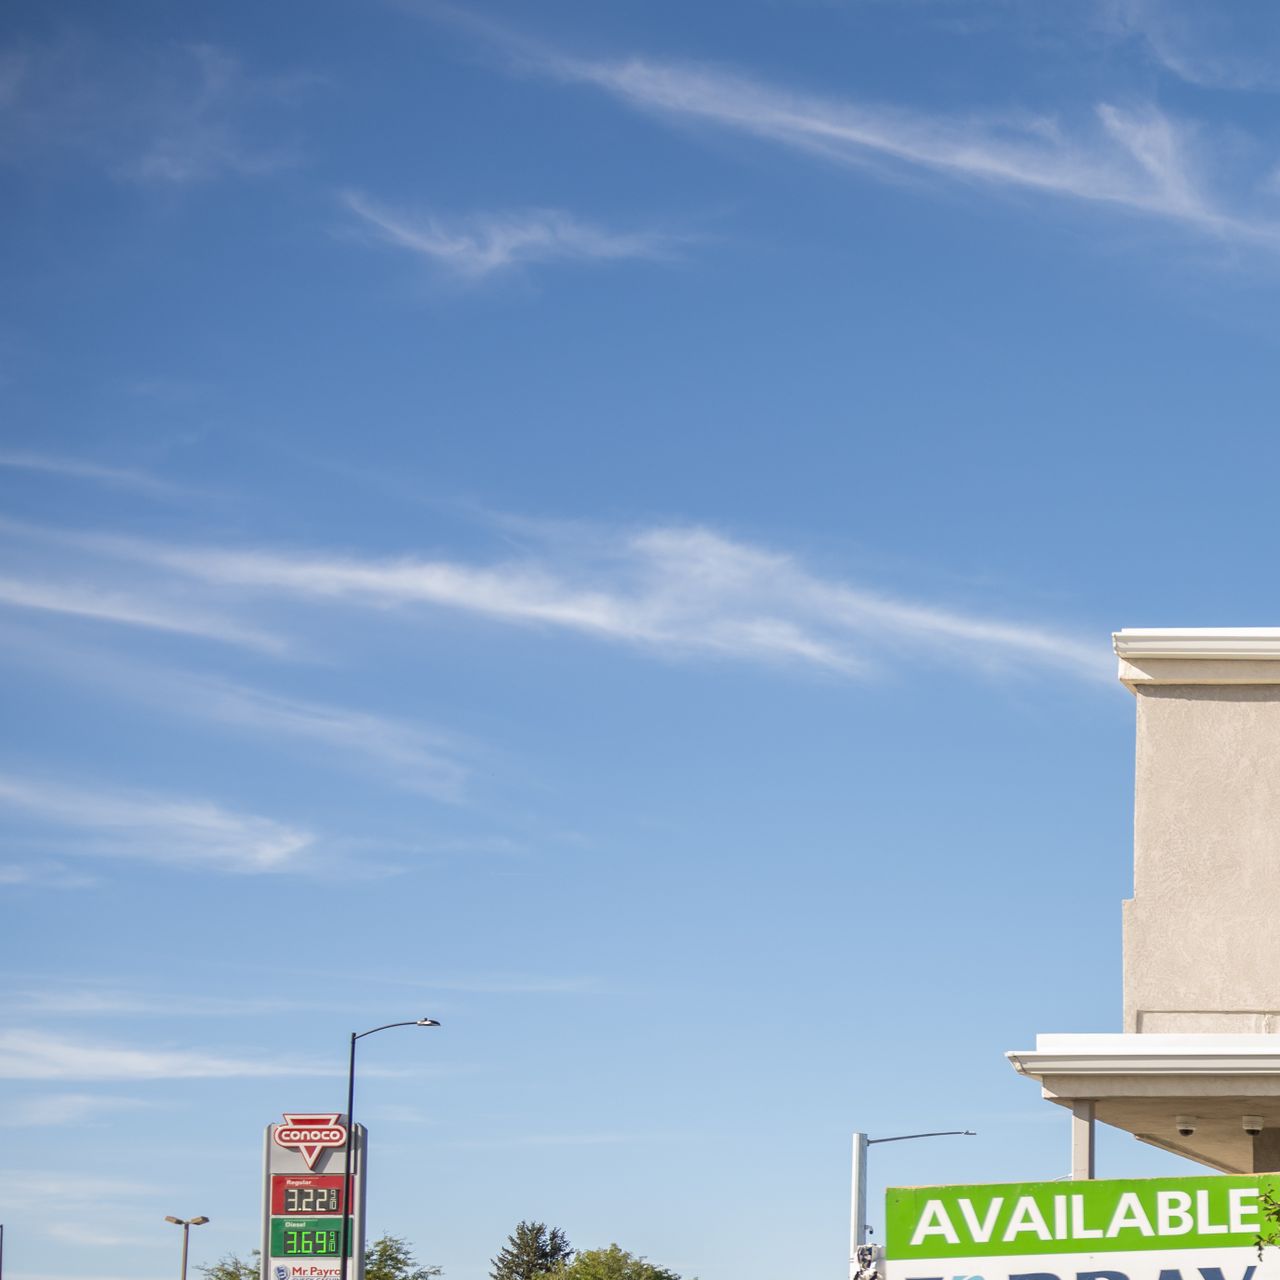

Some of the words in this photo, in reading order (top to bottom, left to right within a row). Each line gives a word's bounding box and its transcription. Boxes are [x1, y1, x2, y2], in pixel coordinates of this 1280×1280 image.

[287, 1189, 327, 1212] 3.22
[909, 1188, 1261, 1245] AVAILABLE
[287, 1231, 327, 1254] 3.69
[292, 1267, 308, 1276] Mr
[310, 1267, 342, 1278] Payro
